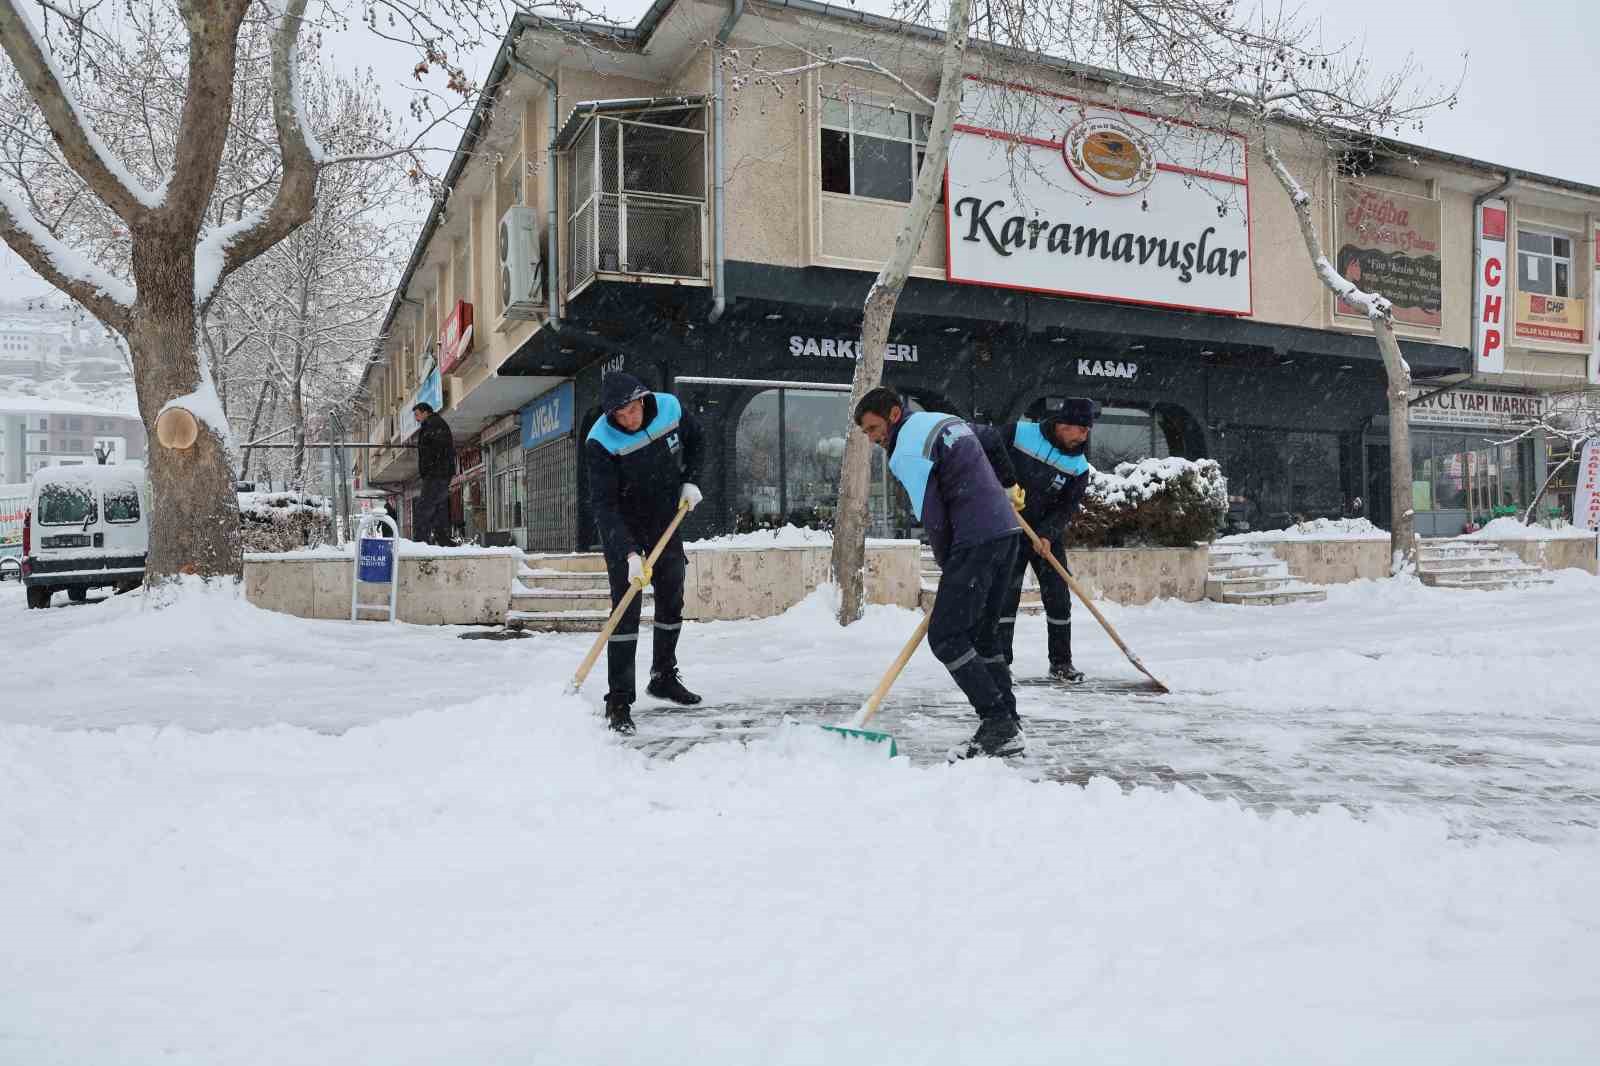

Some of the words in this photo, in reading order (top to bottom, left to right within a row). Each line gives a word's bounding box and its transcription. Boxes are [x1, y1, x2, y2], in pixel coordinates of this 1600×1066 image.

[953, 195, 1249, 284] Karamavuşlar
[1482, 257, 1502, 358] CHP
[1546, 301, 1565, 313] CHP
[789, 335, 918, 362] ŞARKERİ
[1078, 358, 1138, 380] KASAP
[1459, 393, 1489, 411] YAPI
[1492, 396, 1543, 416] MARKET
[531, 398, 560, 439] AYGAZ
